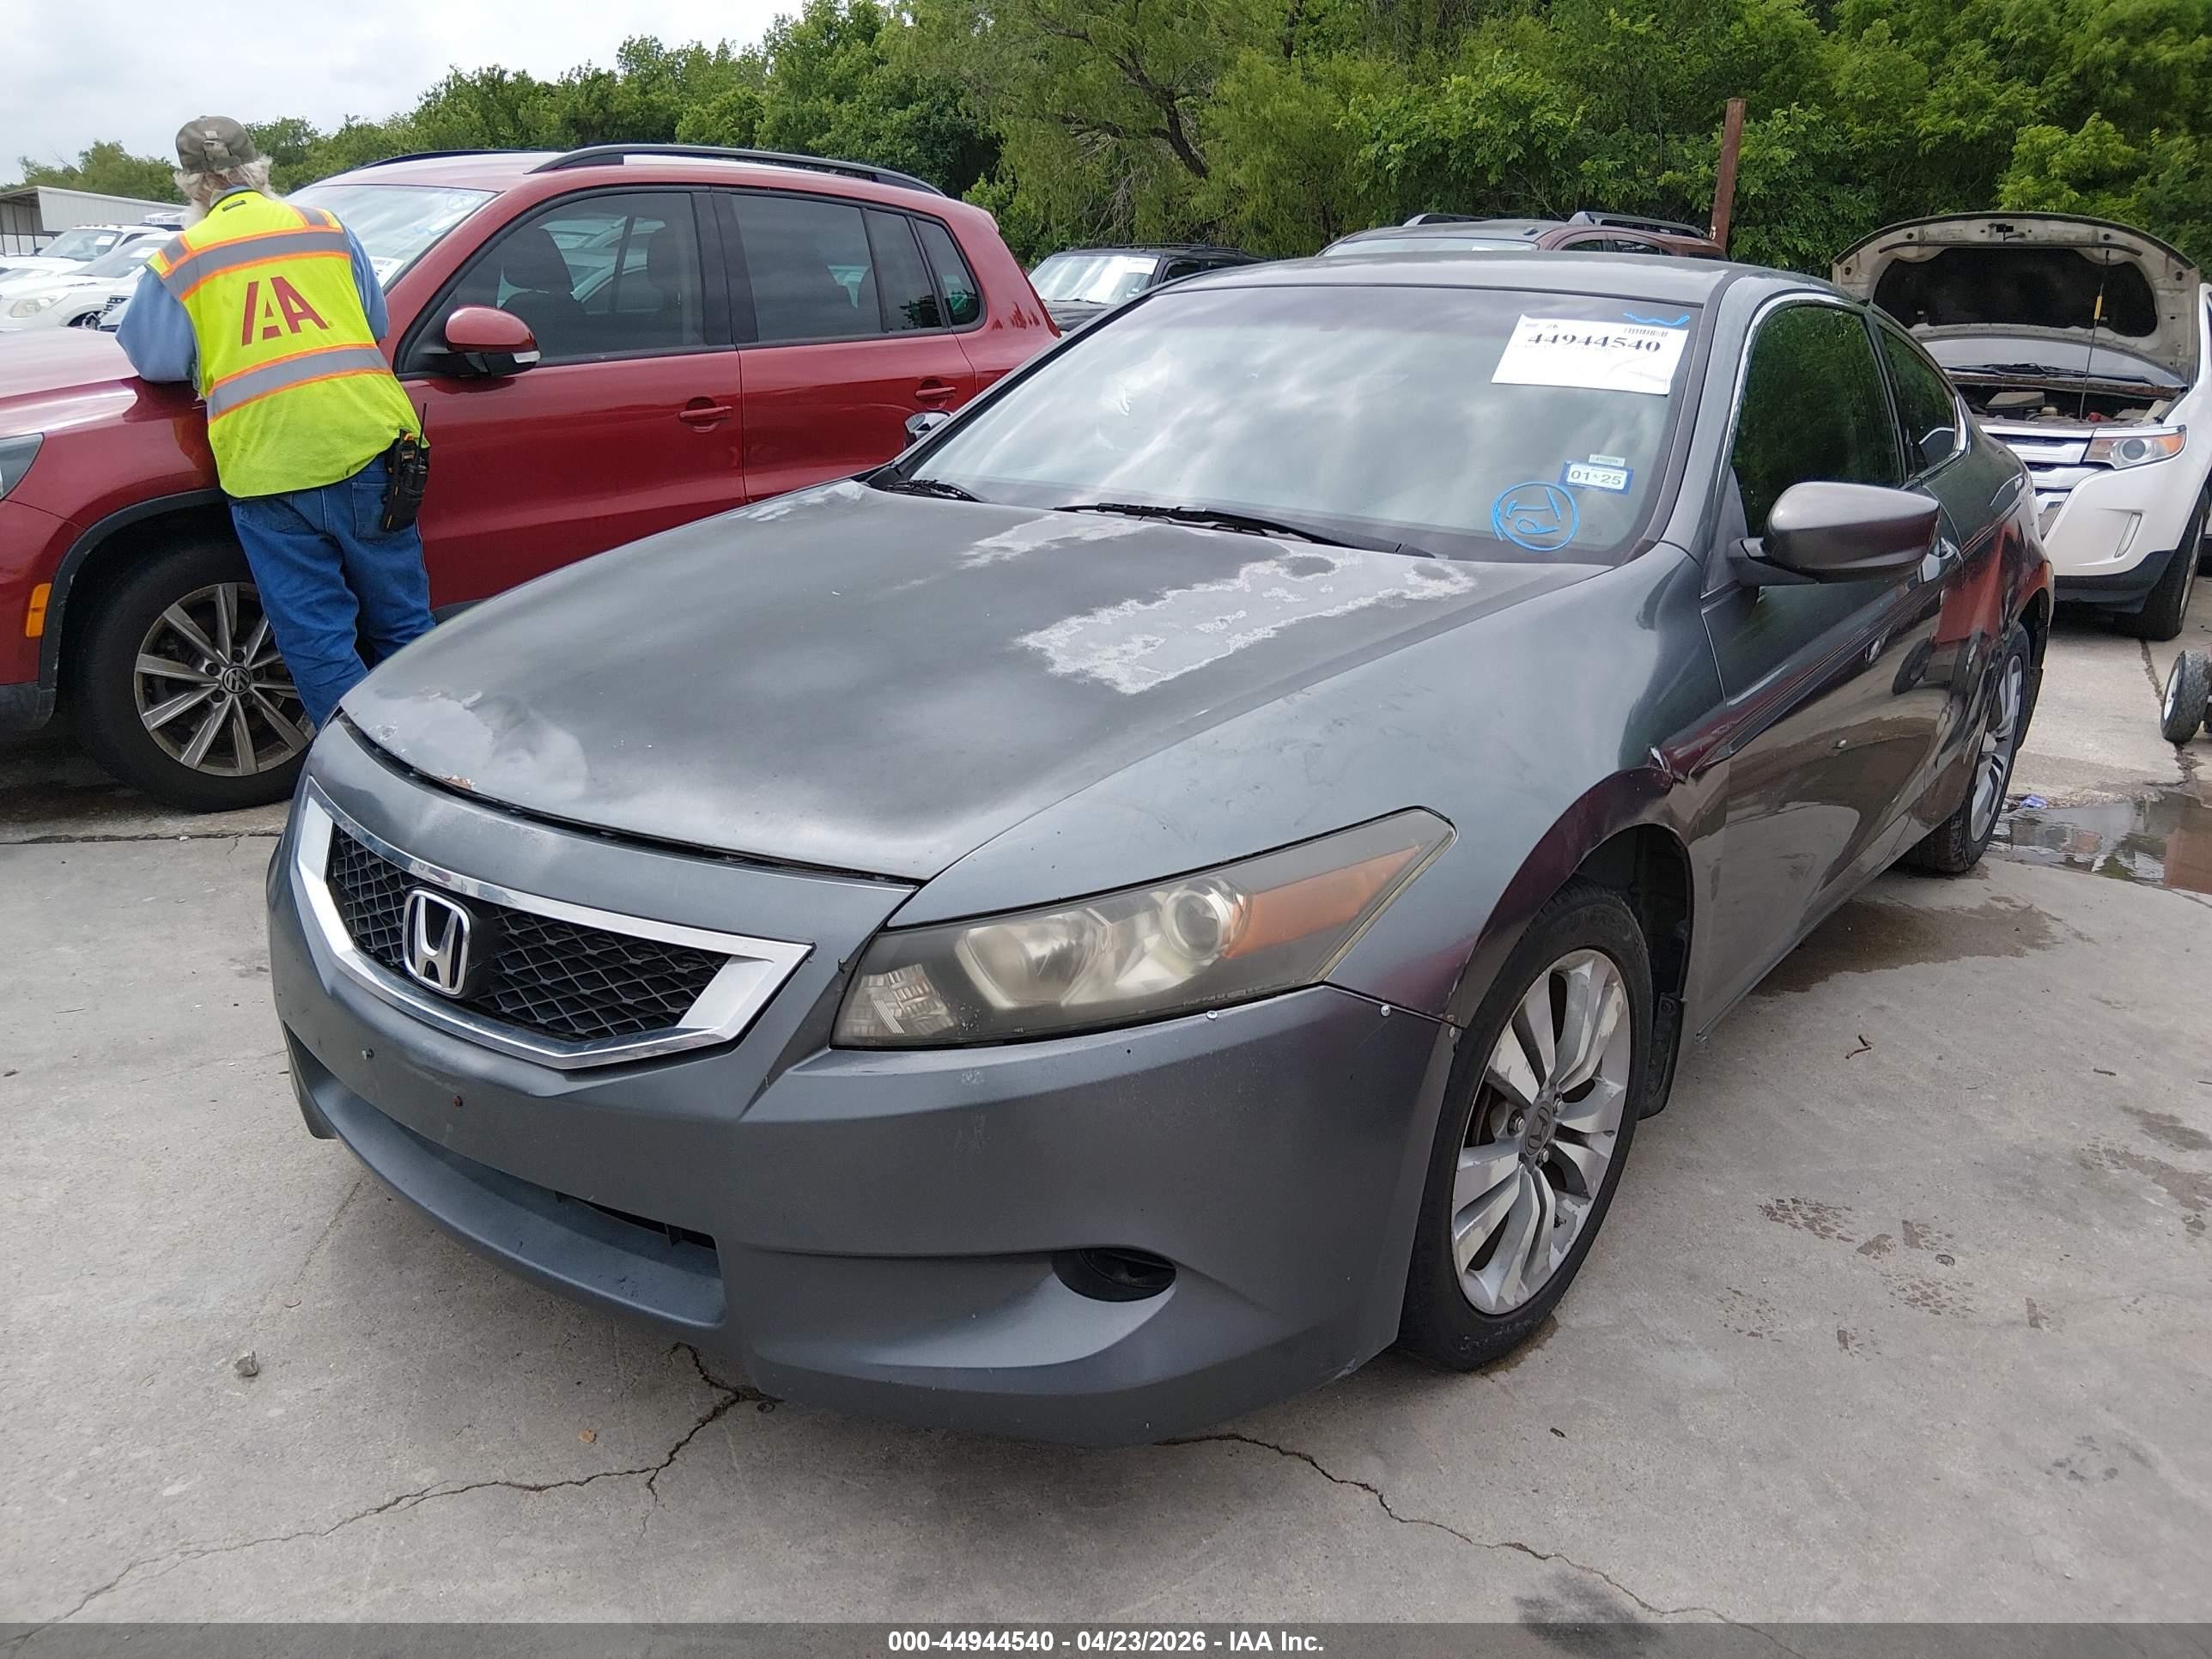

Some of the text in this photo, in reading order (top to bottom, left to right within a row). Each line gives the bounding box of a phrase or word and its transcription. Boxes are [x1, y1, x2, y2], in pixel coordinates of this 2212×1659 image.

[1528, 332, 1661, 352] 44944540
[1571, 470, 1622, 486] 01 25
